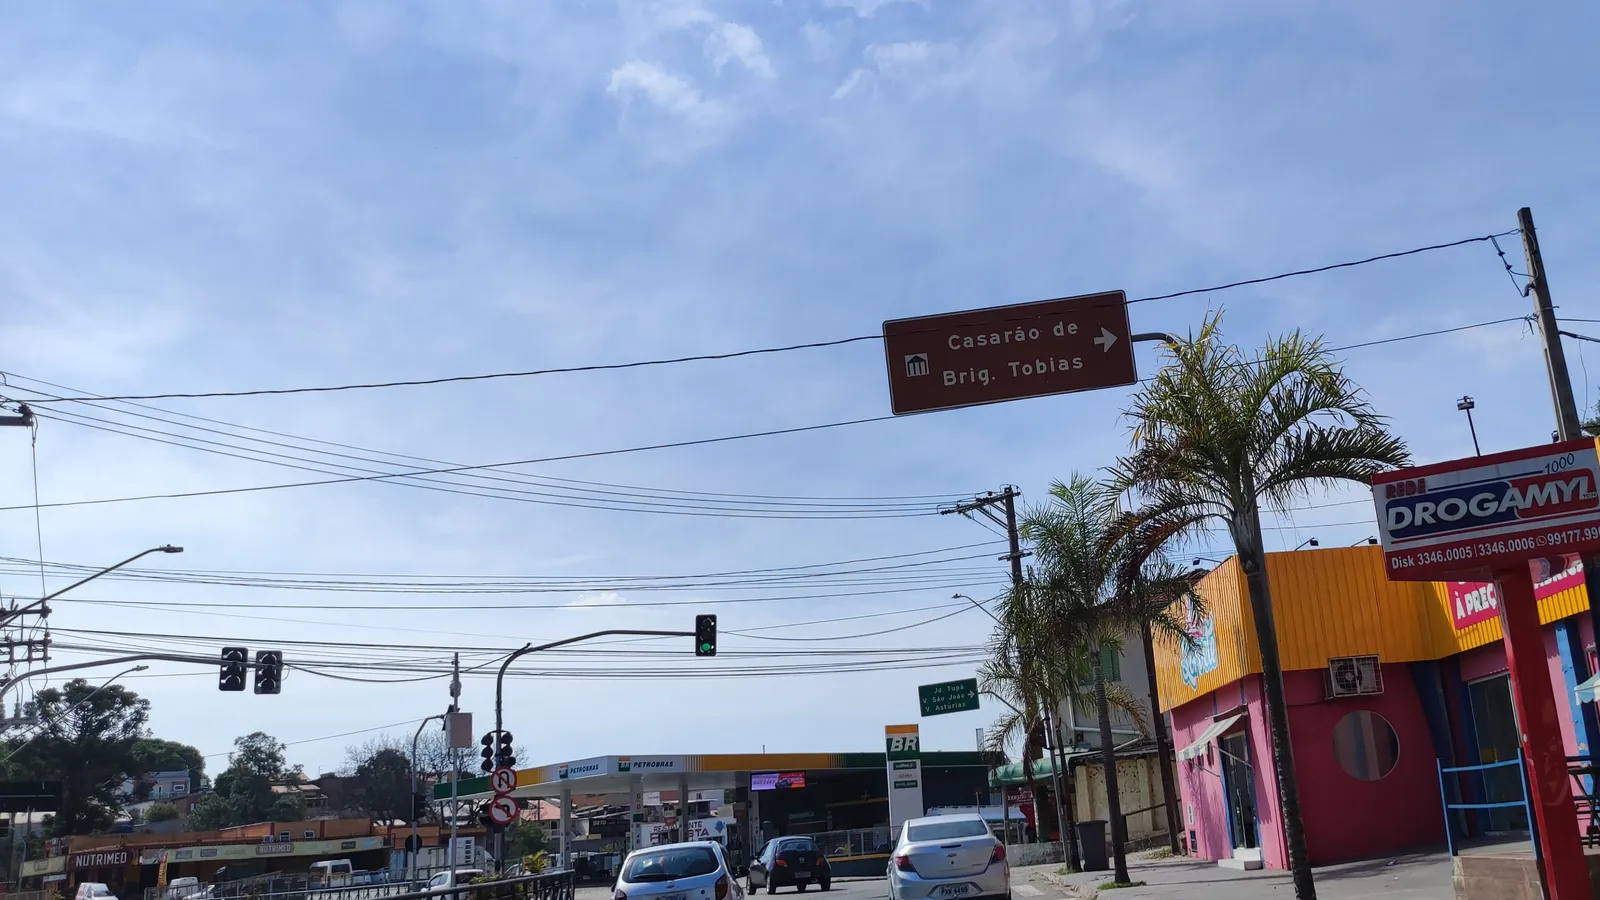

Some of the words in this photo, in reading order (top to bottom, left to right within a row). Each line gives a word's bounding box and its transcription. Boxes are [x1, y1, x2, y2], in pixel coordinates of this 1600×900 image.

[948, 326, 1040, 350] Casarão
[1053, 321, 1078, 337] de
[943, 368, 996, 387] Brig.
[1008, 356, 1083, 377] Tobias
[1545, 453, 1575, 475] 1000
[1386, 478, 1426, 499] REDE
[1387, 476, 1589, 531] DROGAMYL
[1391, 553, 1416, 569] Disk
[1417, 546, 1473, 566] 3346.0005
[1478, 536, 1535, 556] 3346.0006
[1455, 590, 1466, 620] À
[1464, 582, 1498, 616] PREÇ
[935, 702, 966, 711] Astúrias
[948, 693, 965, 701] João
[891, 736, 917, 752] BR
[570, 764, 599, 774] PETROBRAS
[76, 851, 127, 867] NUTRIMED
[260, 844, 291, 853] NUTRIMED
